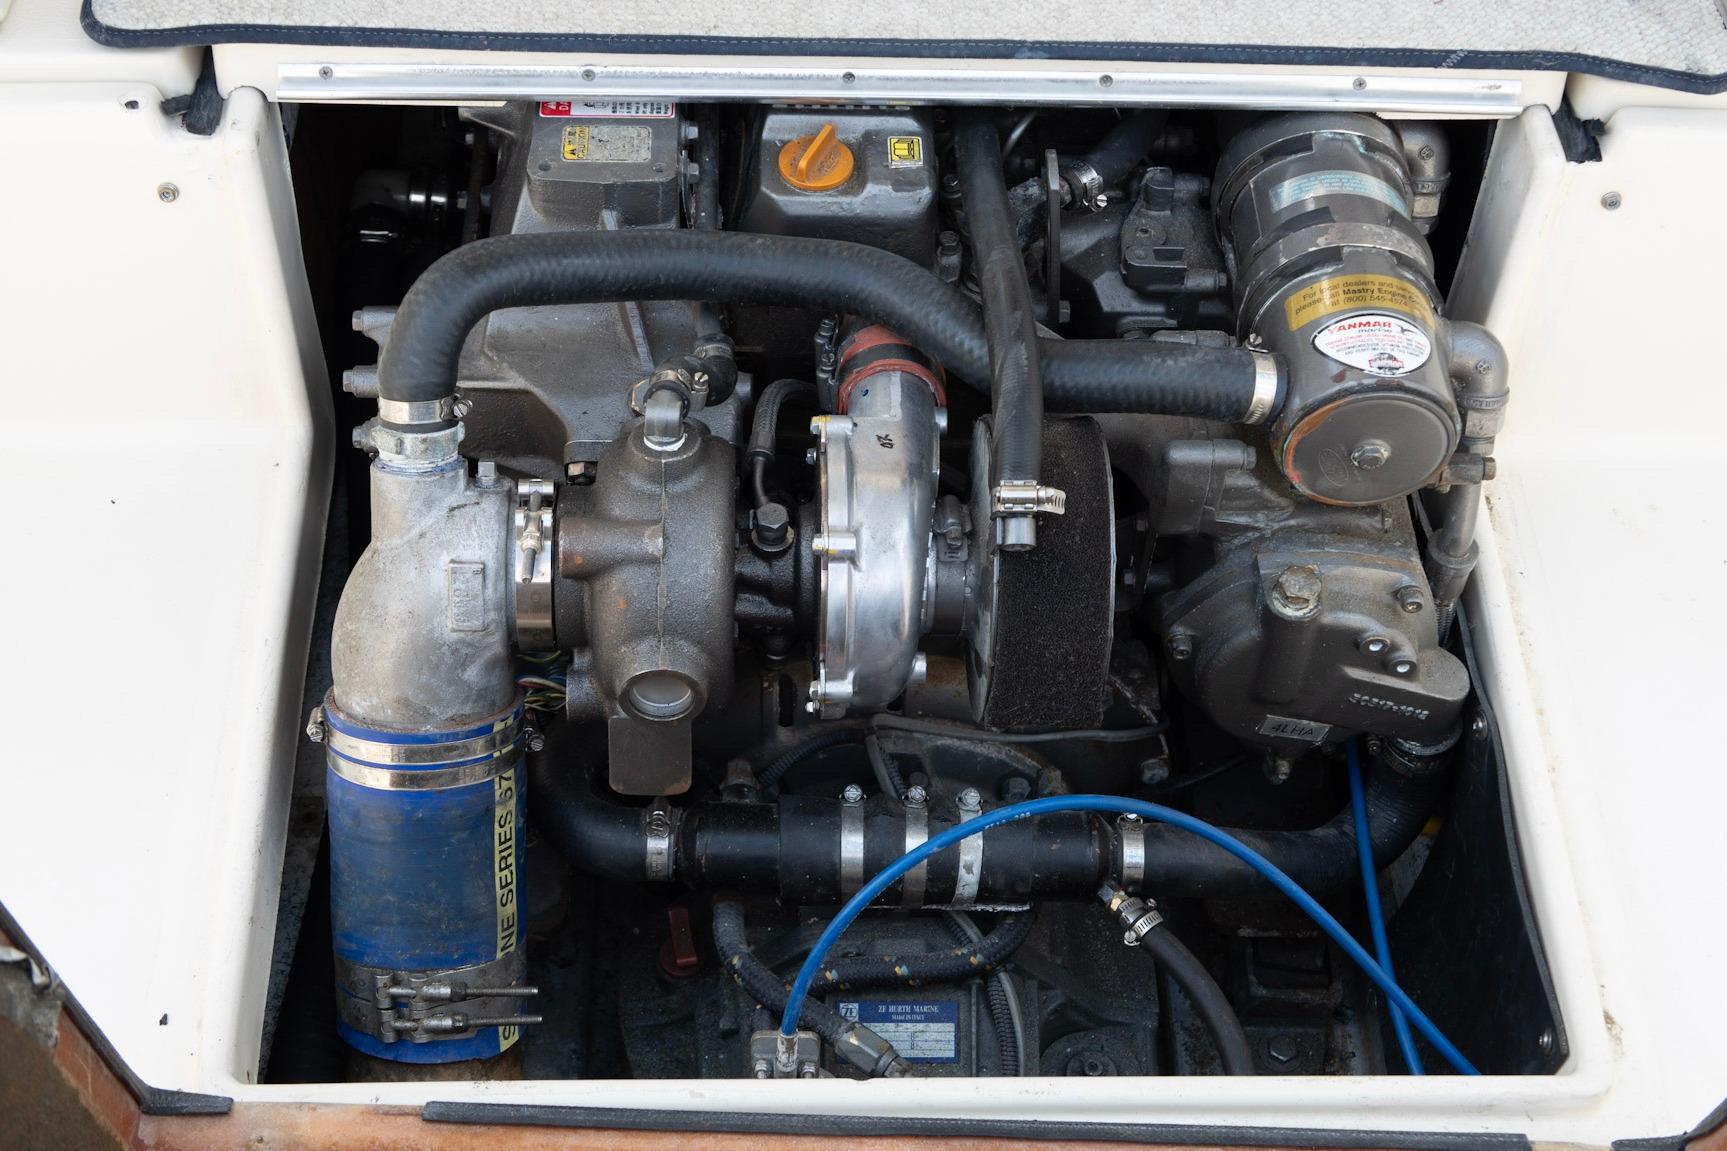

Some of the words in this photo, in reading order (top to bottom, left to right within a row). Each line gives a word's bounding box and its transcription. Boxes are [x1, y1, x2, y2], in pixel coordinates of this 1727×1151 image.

[1302, 291, 1317, 302] For
[1343, 278, 1376, 288] dealers
[1343, 287, 1379, 297] Mastry
[1343, 295, 1367, 305] (800)
[1328, 320, 1392, 335] YANMAR
[1271, 723, 1314, 737] 4LHA
[499, 813, 514, 905] SERIES
[878, 1005, 886, 1013] ZF
[888, 1005, 911, 1013] HURTH
[913, 1005, 940, 1013] MARINE
